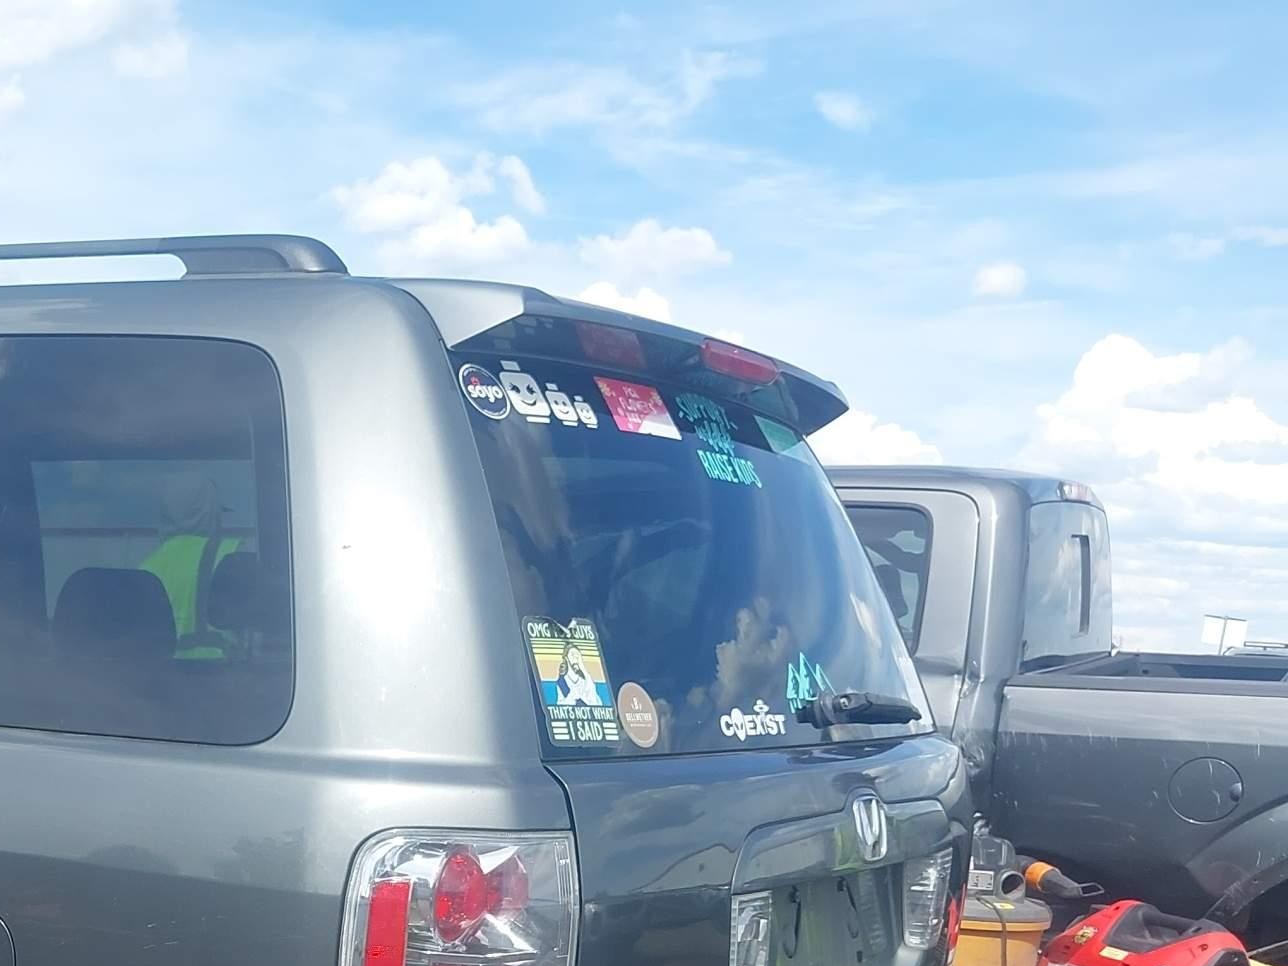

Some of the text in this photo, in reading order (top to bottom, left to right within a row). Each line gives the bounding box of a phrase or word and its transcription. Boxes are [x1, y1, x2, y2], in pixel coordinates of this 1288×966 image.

[696, 449, 762, 489] RAISE KIDS
[527, 622, 551, 638] OMG
[571, 624, 595, 640] GUYS
[548, 706, 615, 720] THAT'S NOT WHAT
[720, 702, 786, 742] COEXIST
[569, 721, 603, 741] I SAID
